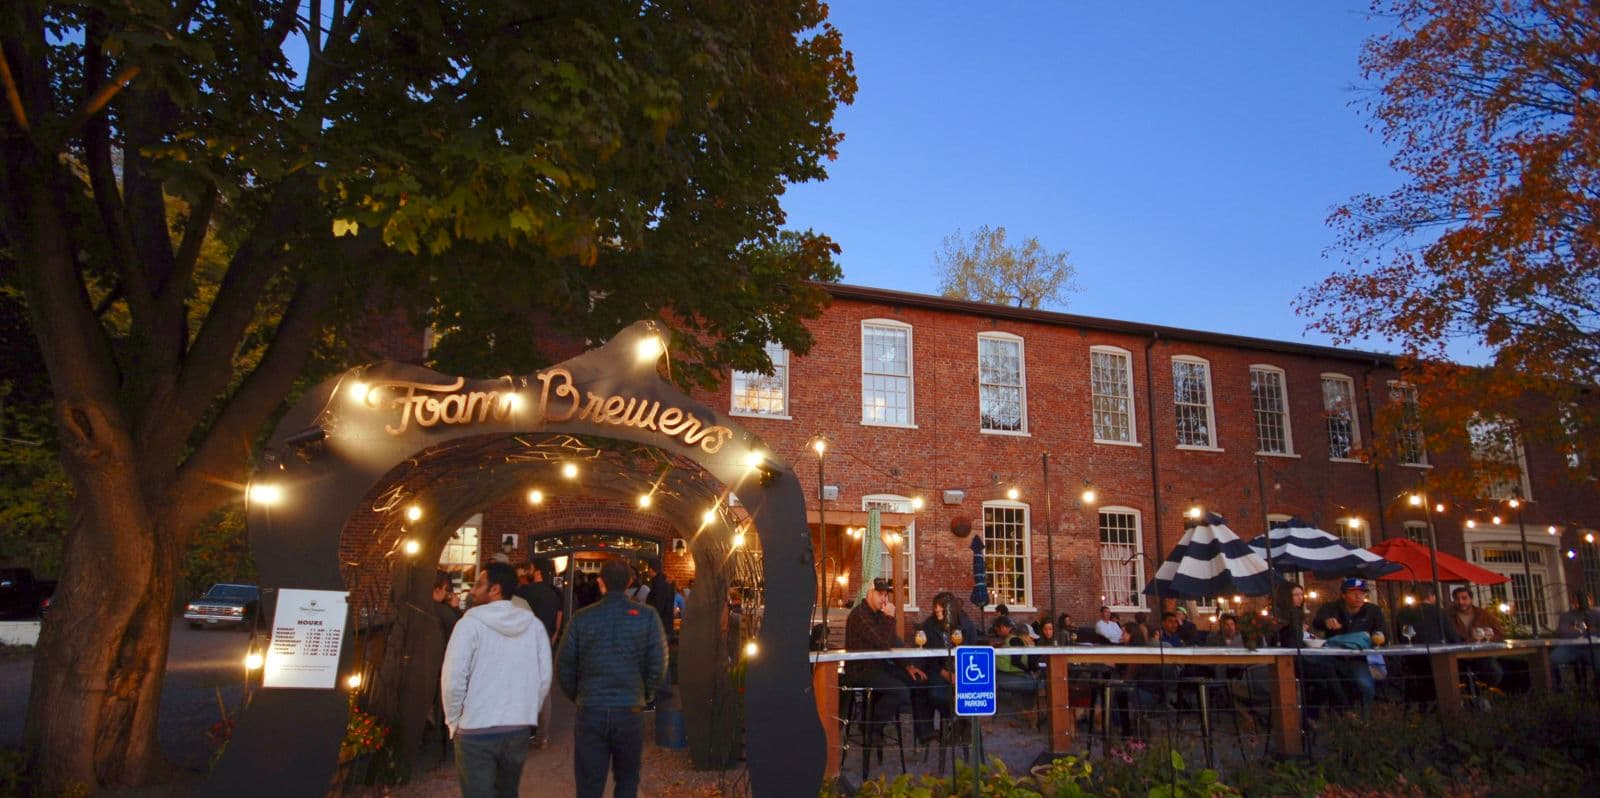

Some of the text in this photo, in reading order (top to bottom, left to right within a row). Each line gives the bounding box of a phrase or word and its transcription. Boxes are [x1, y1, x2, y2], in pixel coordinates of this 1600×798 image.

[367, 368, 733, 455] Foam Brewers
[957, 692, 994, 700] HANDICAPPED
